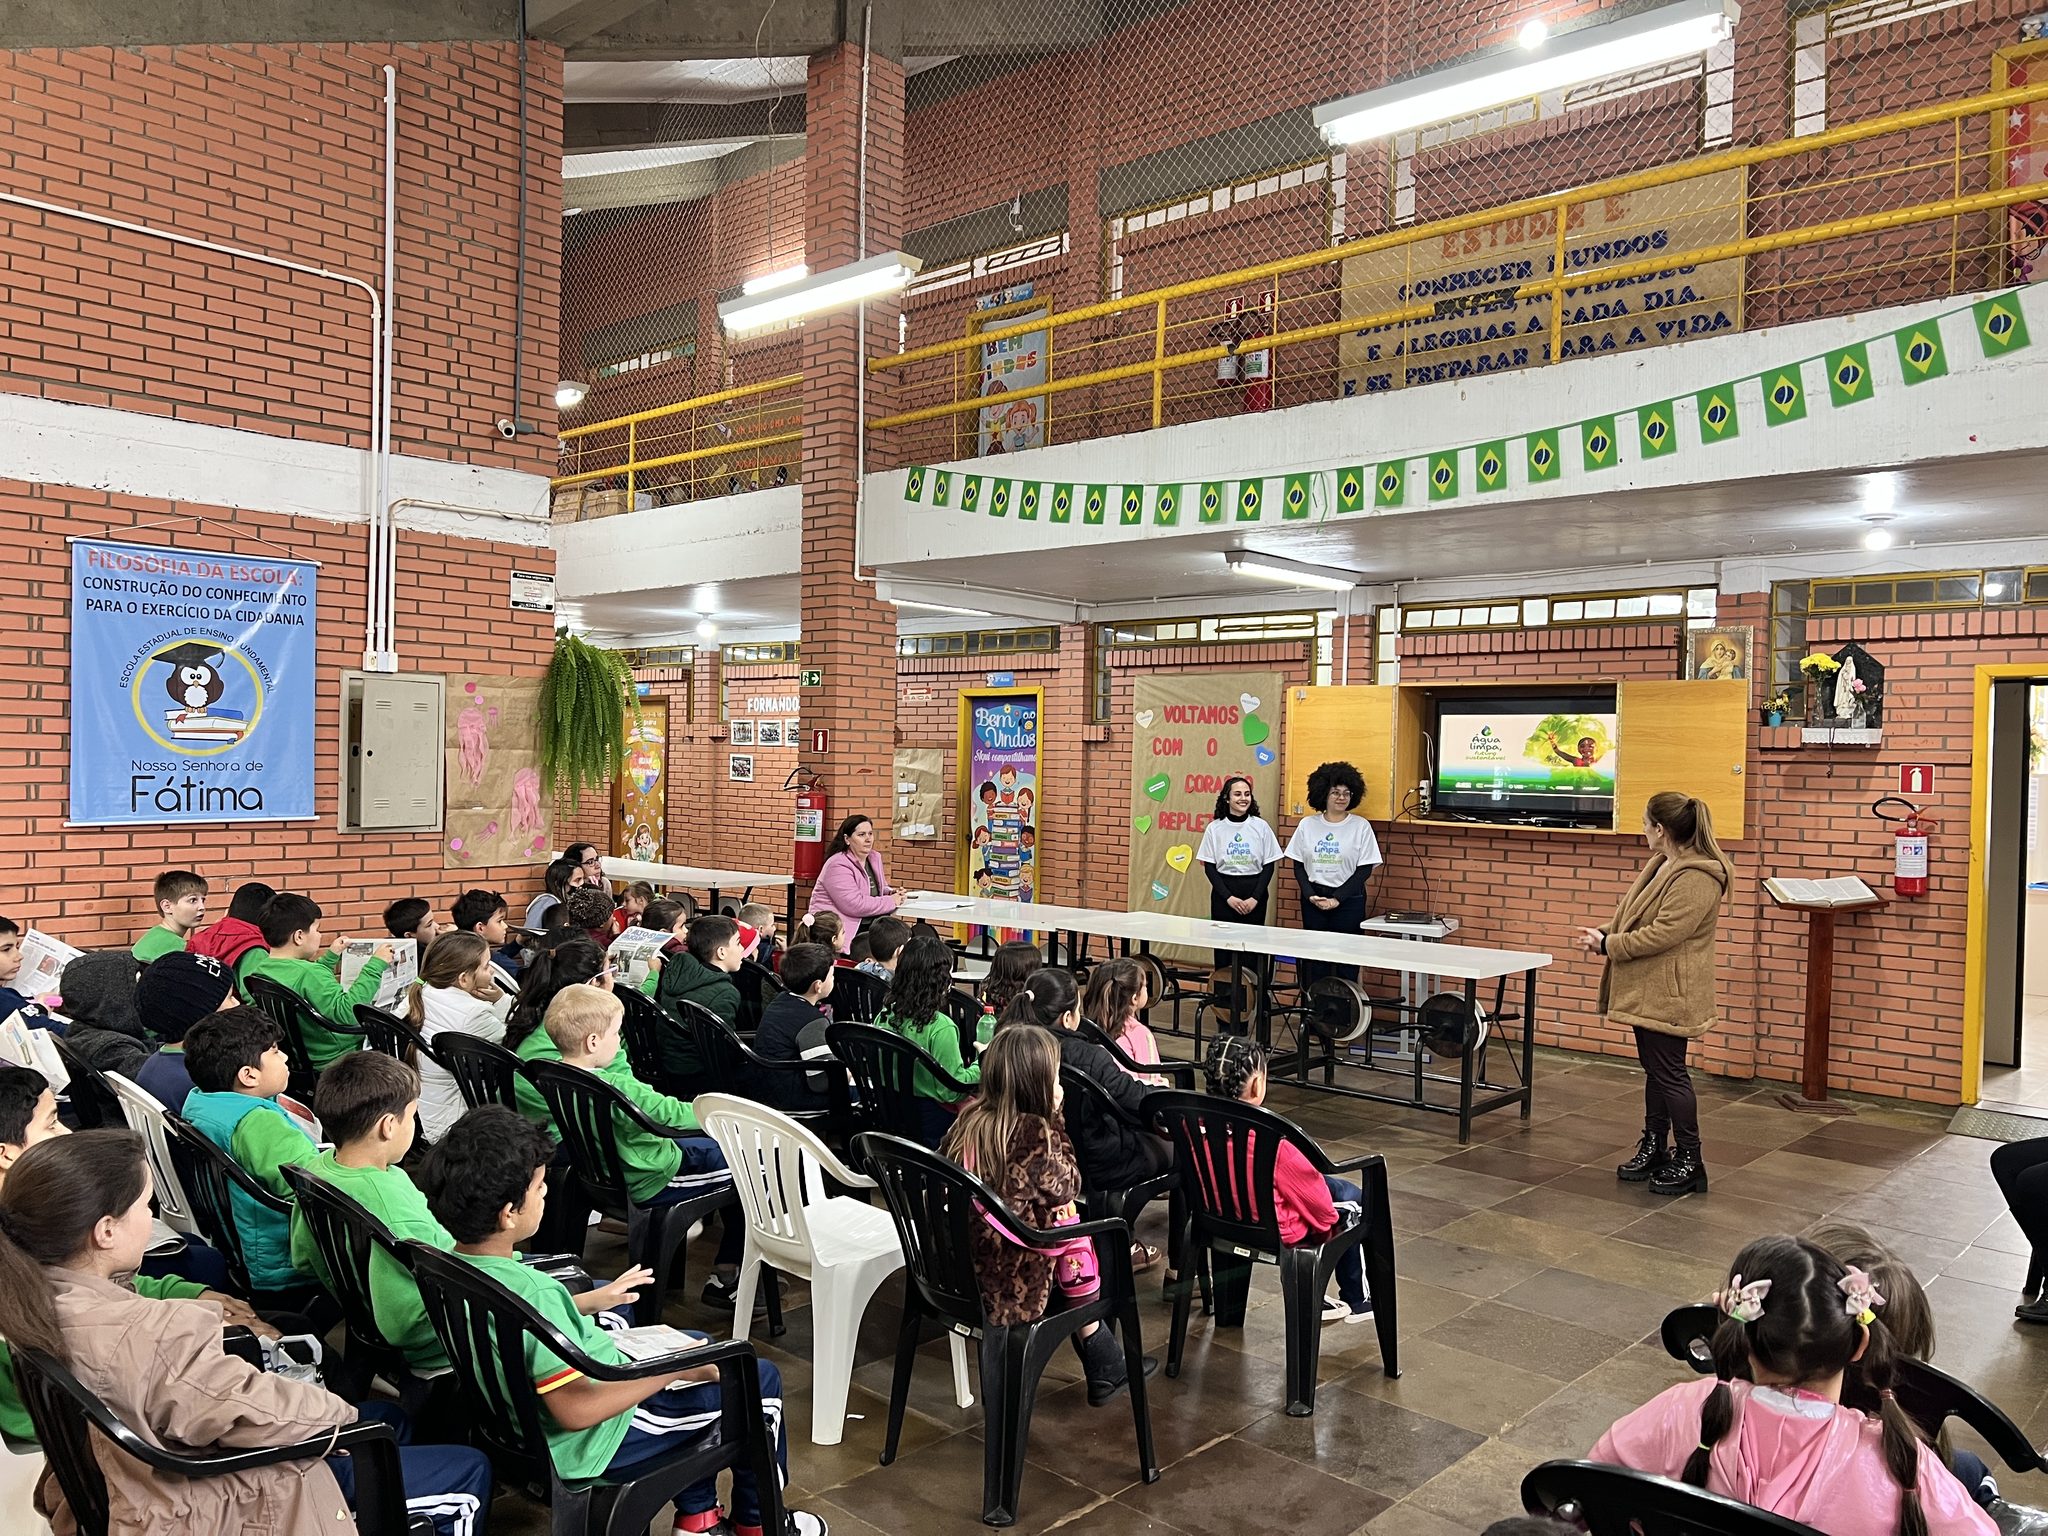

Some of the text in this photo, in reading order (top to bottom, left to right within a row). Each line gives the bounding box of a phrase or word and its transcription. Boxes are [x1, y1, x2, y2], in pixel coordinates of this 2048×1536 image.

[1398, 260, 1533, 301] CONHECER
[1367, 345, 1381, 362] E
[1393, 321, 1516, 358] ALEGRIAS
[1525, 316, 1543, 334] A
[1343, 379, 1356, 396] E
[1406, 348, 1529, 384] PREPARAR
[1625, 326, 1646, 345] A
[1656, 311, 1732, 339] VIDA
[88, 550, 303, 586] FILOSOFIA DA ESCOLA:
[83, 577, 178, 597] CONSTRUÇÃO
[182, 585, 202, 598] DO
[86, 598, 304, 626] PARA O EXERCÍCIO DA CIDADANIA
[119, 627, 277, 694] ESCOLA ESTADUAL DE ENSINO UNDAMENTAL
[747, 696, 800, 713] FORMANDO
[1163, 705, 1239, 724] VOLTAMOS
[975, 707, 1016, 727] Bem
[985, 726, 1036, 747] Vindos
[1152, 737, 1218, 757] COM O
[1472, 734, 1500, 744] Água
[132, 760, 263, 771] Nossa Senhora de
[132, 775, 263, 812] Fátima
[1184, 771, 1254, 794] CORAO
